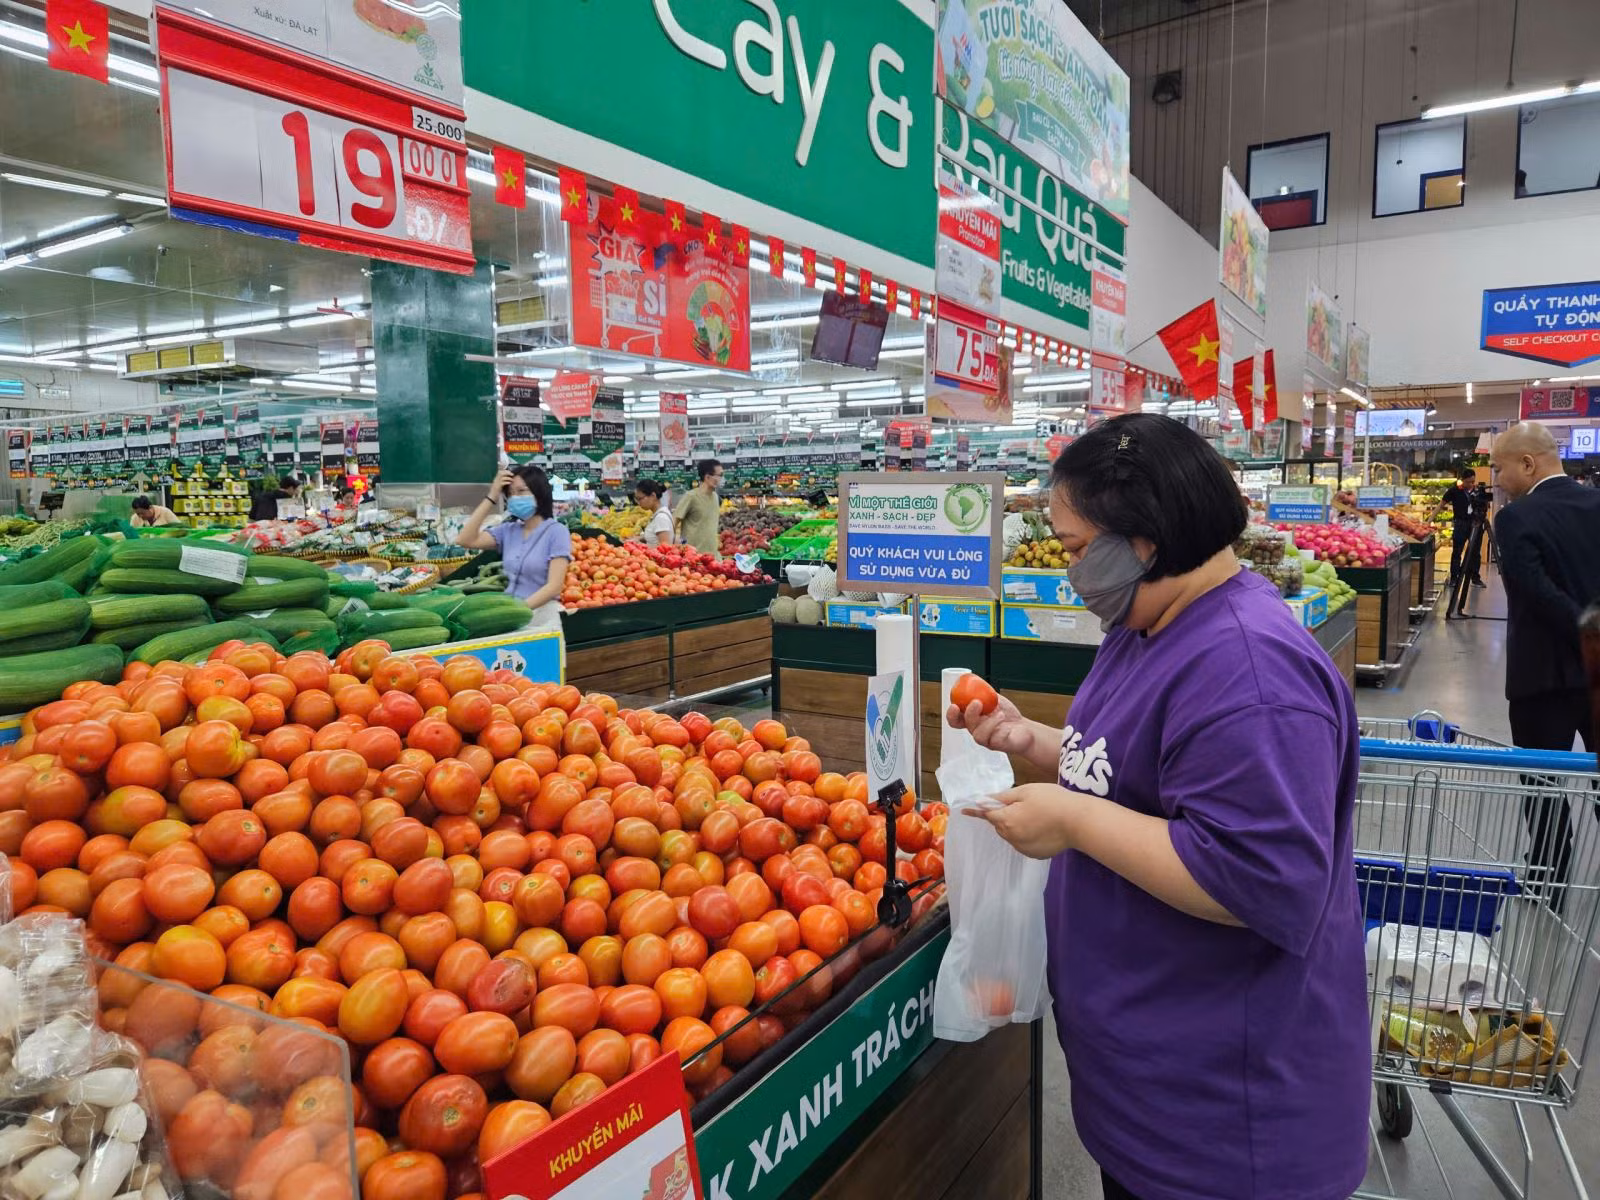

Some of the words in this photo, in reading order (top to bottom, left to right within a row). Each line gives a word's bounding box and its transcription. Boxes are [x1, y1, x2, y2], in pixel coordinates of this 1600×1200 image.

[868, 42, 913, 168] &
[416, 115, 463, 141] 25.000
[282, 110, 397, 228] 19
[1002, 249, 1035, 288] Fruits
[1036, 266, 1046, 292] &
[1046, 270, 1091, 312] Vegetable
[1546, 293, 1600, 309] THANH
[1534, 314, 1559, 328] TỰ
[1504, 337, 1529, 346] SELF
[1532, 333, 1588, 344] CHECKOUT
[1591, 333, 1600, 342] C
[956, 326, 983, 377] 75
[1577, 436, 1591, 446] 10
[861, 496, 887, 511] MỘT
[849, 511, 875, 520] XANH
[882, 512, 908, 522] SẠCH
[916, 513, 936, 523] ĐẸP
[849, 545, 874, 559] QUÝ
[878, 546, 920, 560] KHÁCH
[923, 549, 945, 561] VUI
[948, 547, 983, 562] LÒNG
[859, 563, 877, 576] SỬ
[880, 565, 914, 579] DỤNG
[951, 566, 971, 580] ĐỦ
[747, 1062, 843, 1192] XANH
[851, 979, 935, 1090] TRÁCH
[548, 1126, 615, 1179] KHUYẾN
[616, 1103, 644, 1135] MÃI
